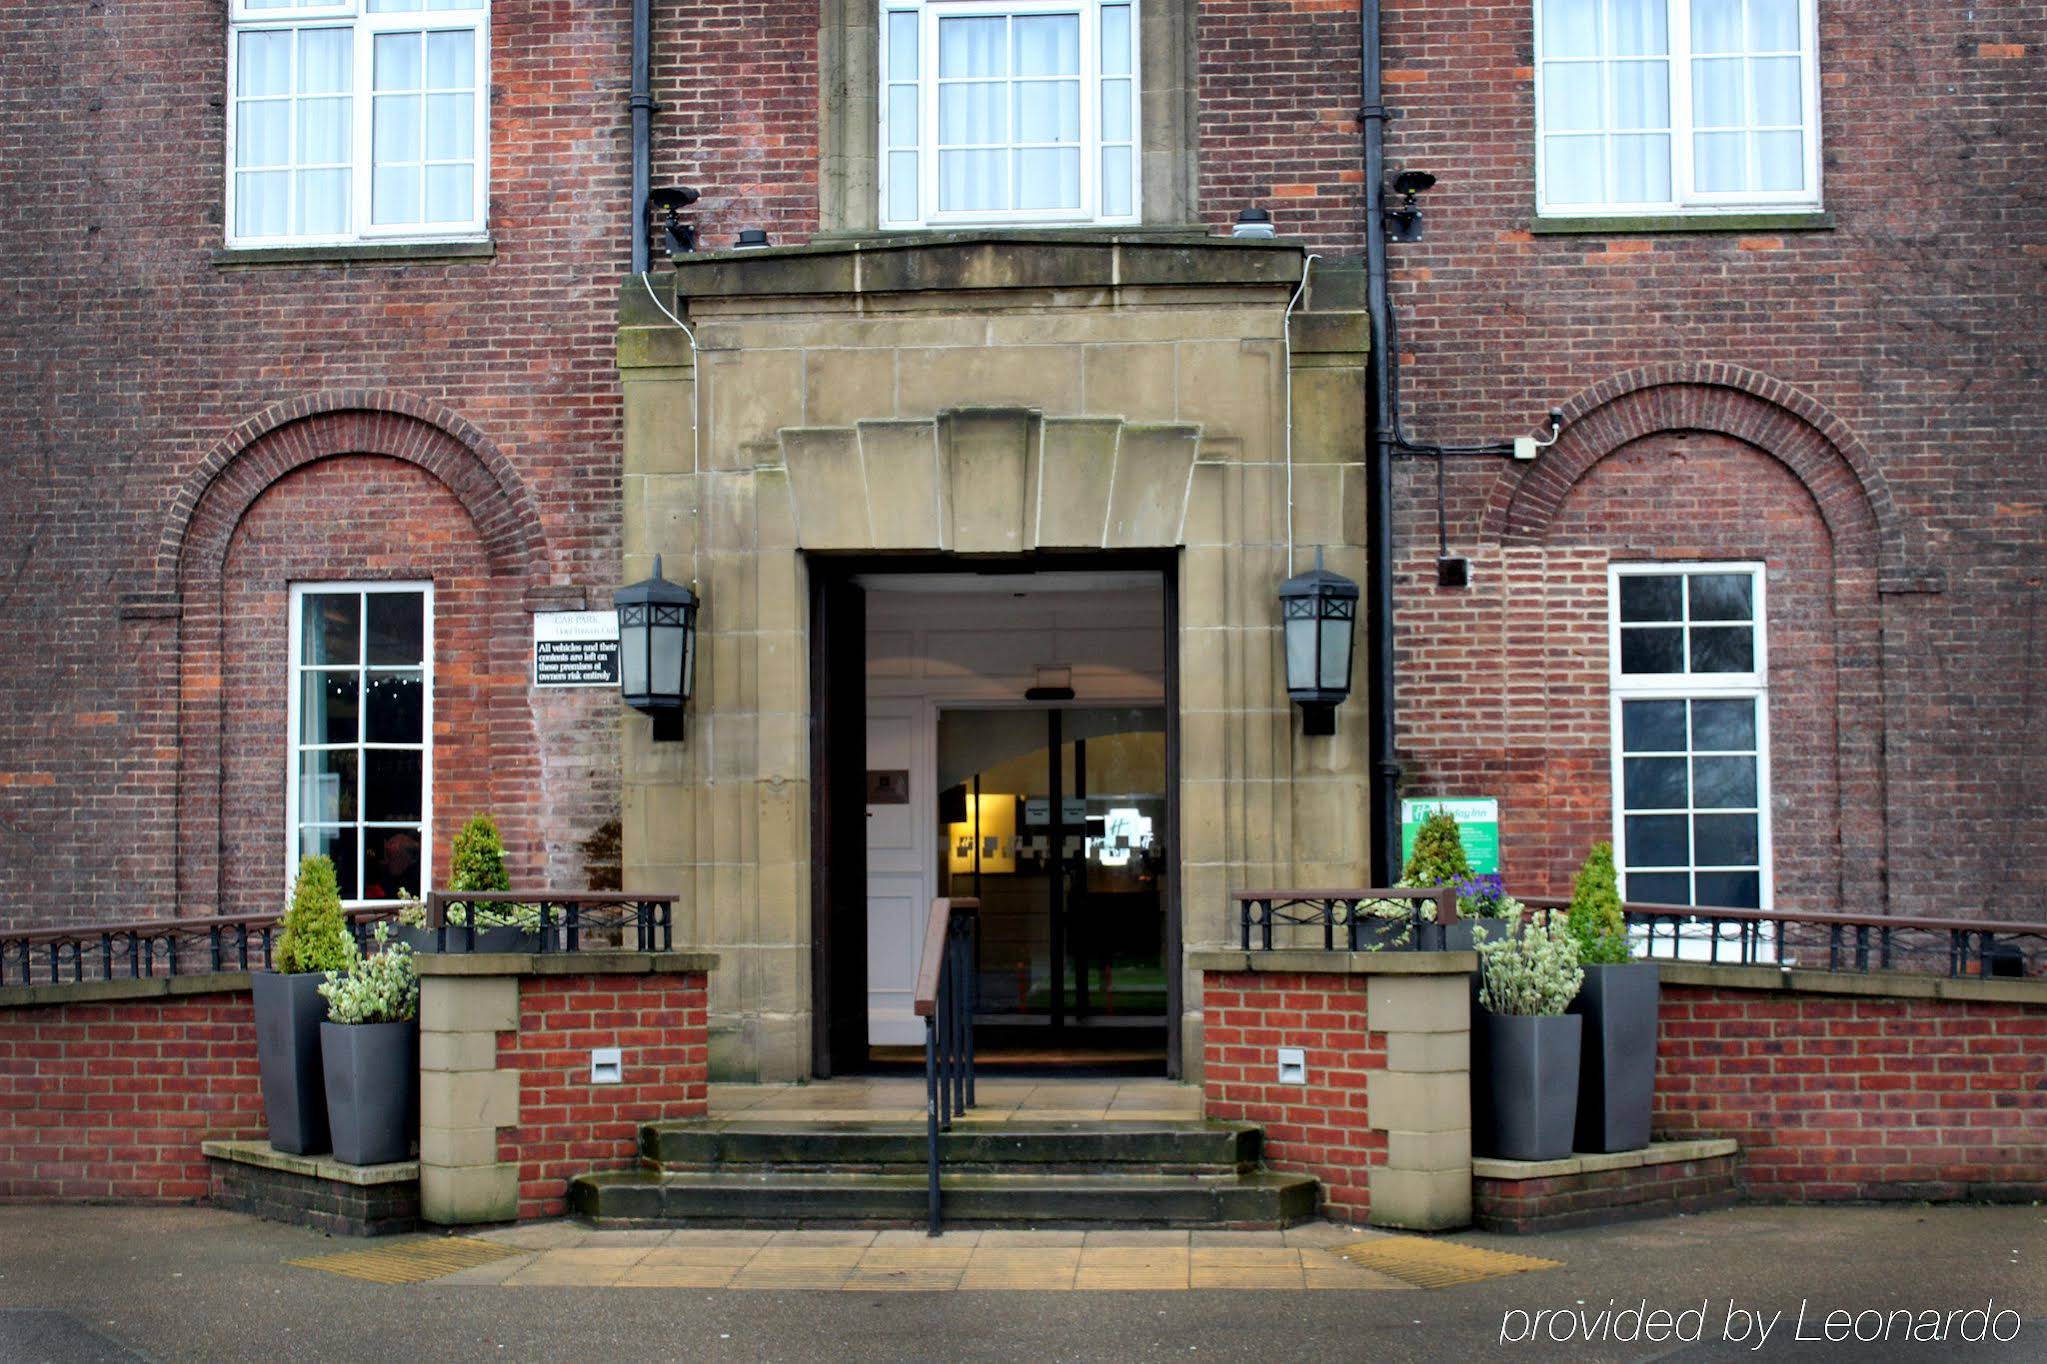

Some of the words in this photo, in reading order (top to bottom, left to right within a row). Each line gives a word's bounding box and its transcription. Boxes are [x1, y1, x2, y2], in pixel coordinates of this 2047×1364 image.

[576, 615, 598, 624] PARK
[538, 643, 551, 652] All
[552, 642, 582, 652] vehicles
[583, 642, 598, 652] and
[600, 642, 617, 652] their
[538, 653, 569, 662] contents
[570, 654, 583, 662] are
[584, 652, 596, 661] left
[597, 654, 608, 662] on
[538, 662, 559, 671] these
[560, 663, 593, 673] premises
[594, 662, 602, 671] at
[538, 672, 567, 681] owners
[568, 671, 581, 680] risk
[583, 671, 611, 682] entirely
